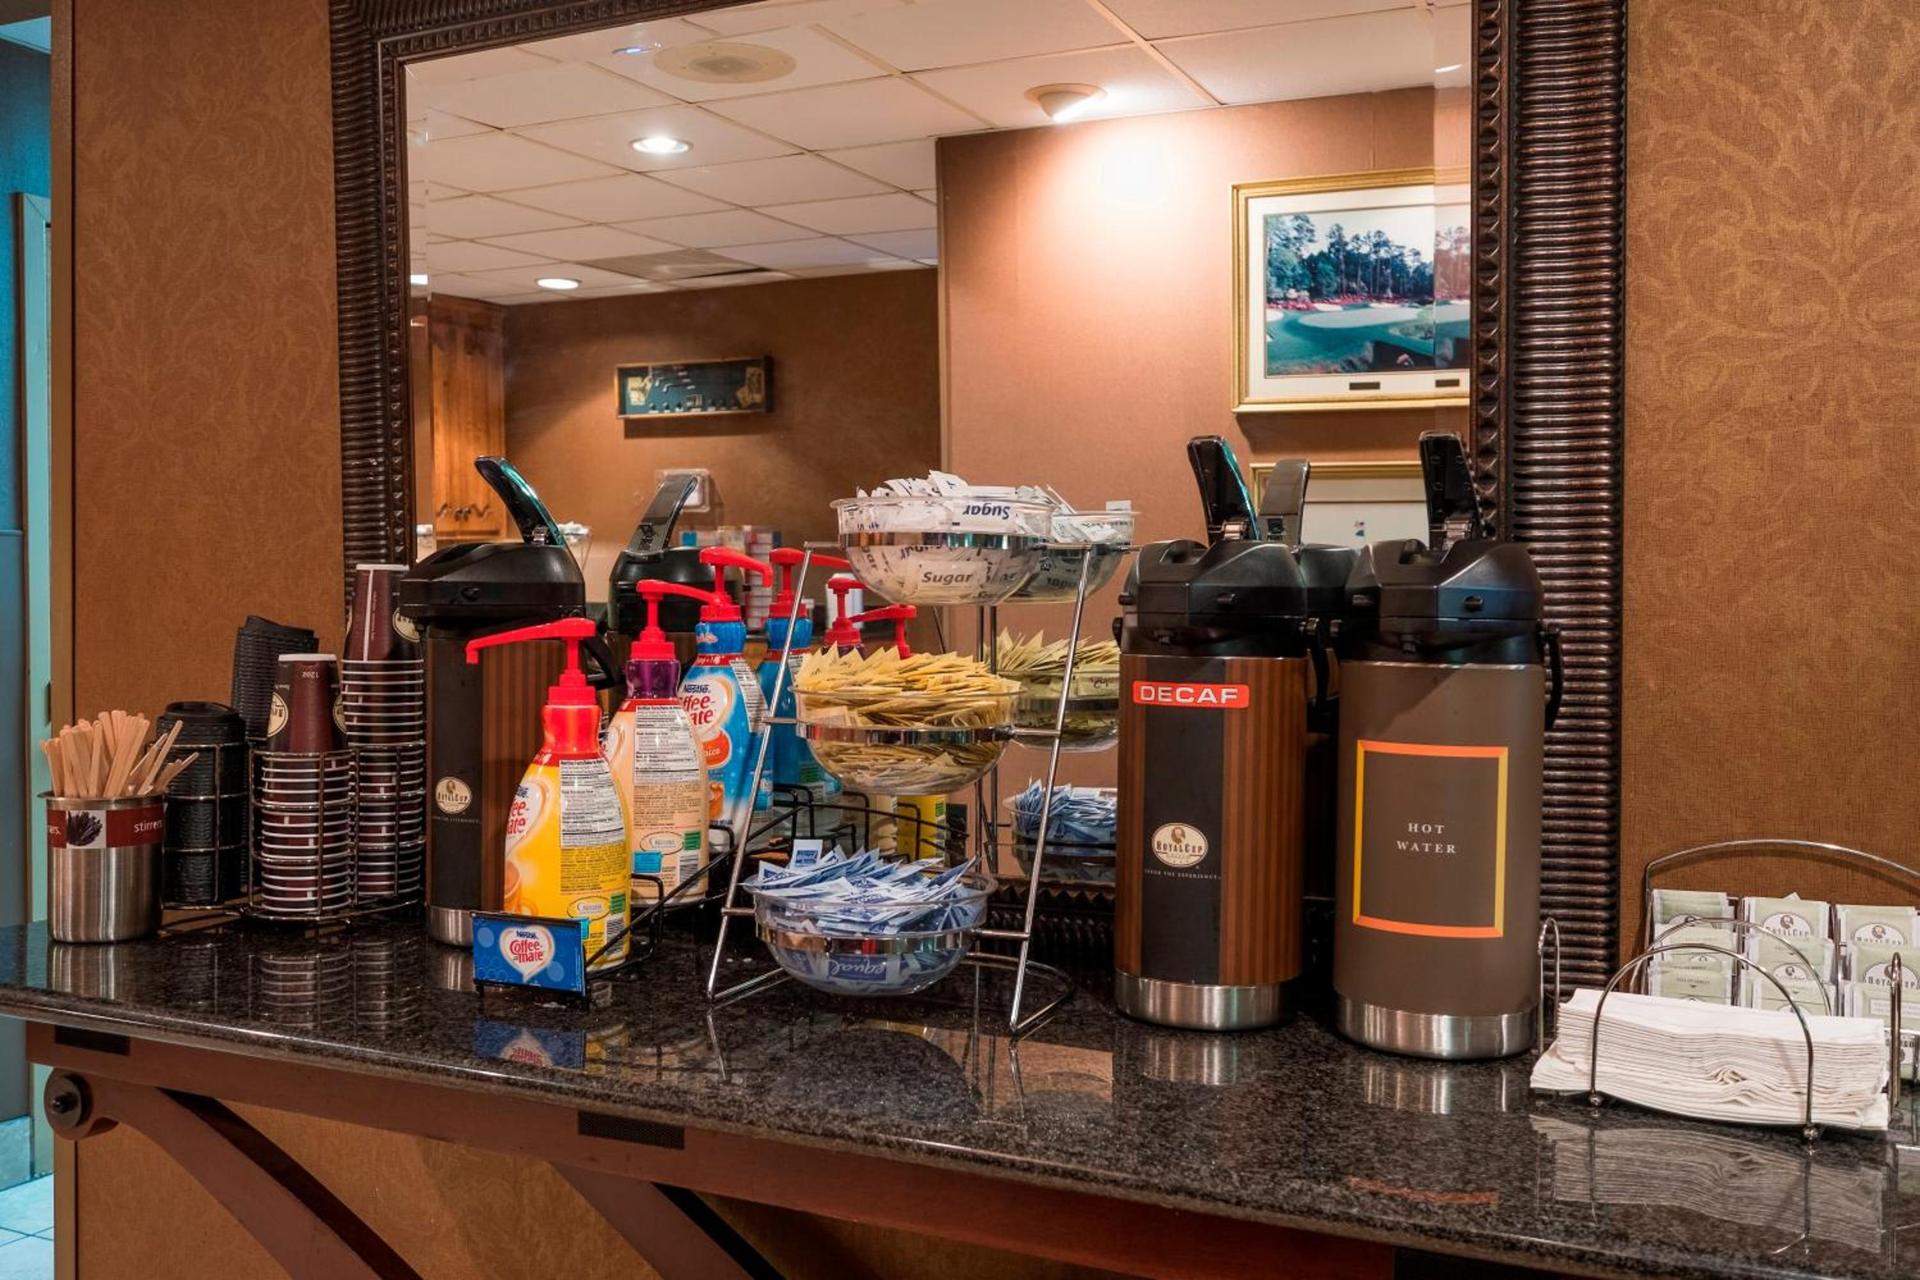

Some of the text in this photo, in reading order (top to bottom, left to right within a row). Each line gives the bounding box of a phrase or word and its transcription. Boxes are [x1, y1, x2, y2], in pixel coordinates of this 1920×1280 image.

[962, 503, 1011, 521] Sugar
[921, 571, 974, 586] Sugar
[1140, 685, 1239, 704] DECAF
[683, 695, 715, 712] ffee-
[1408, 822, 1445, 834] HOT
[1396, 840, 1456, 854] WATER
[827, 958, 885, 976] equal
